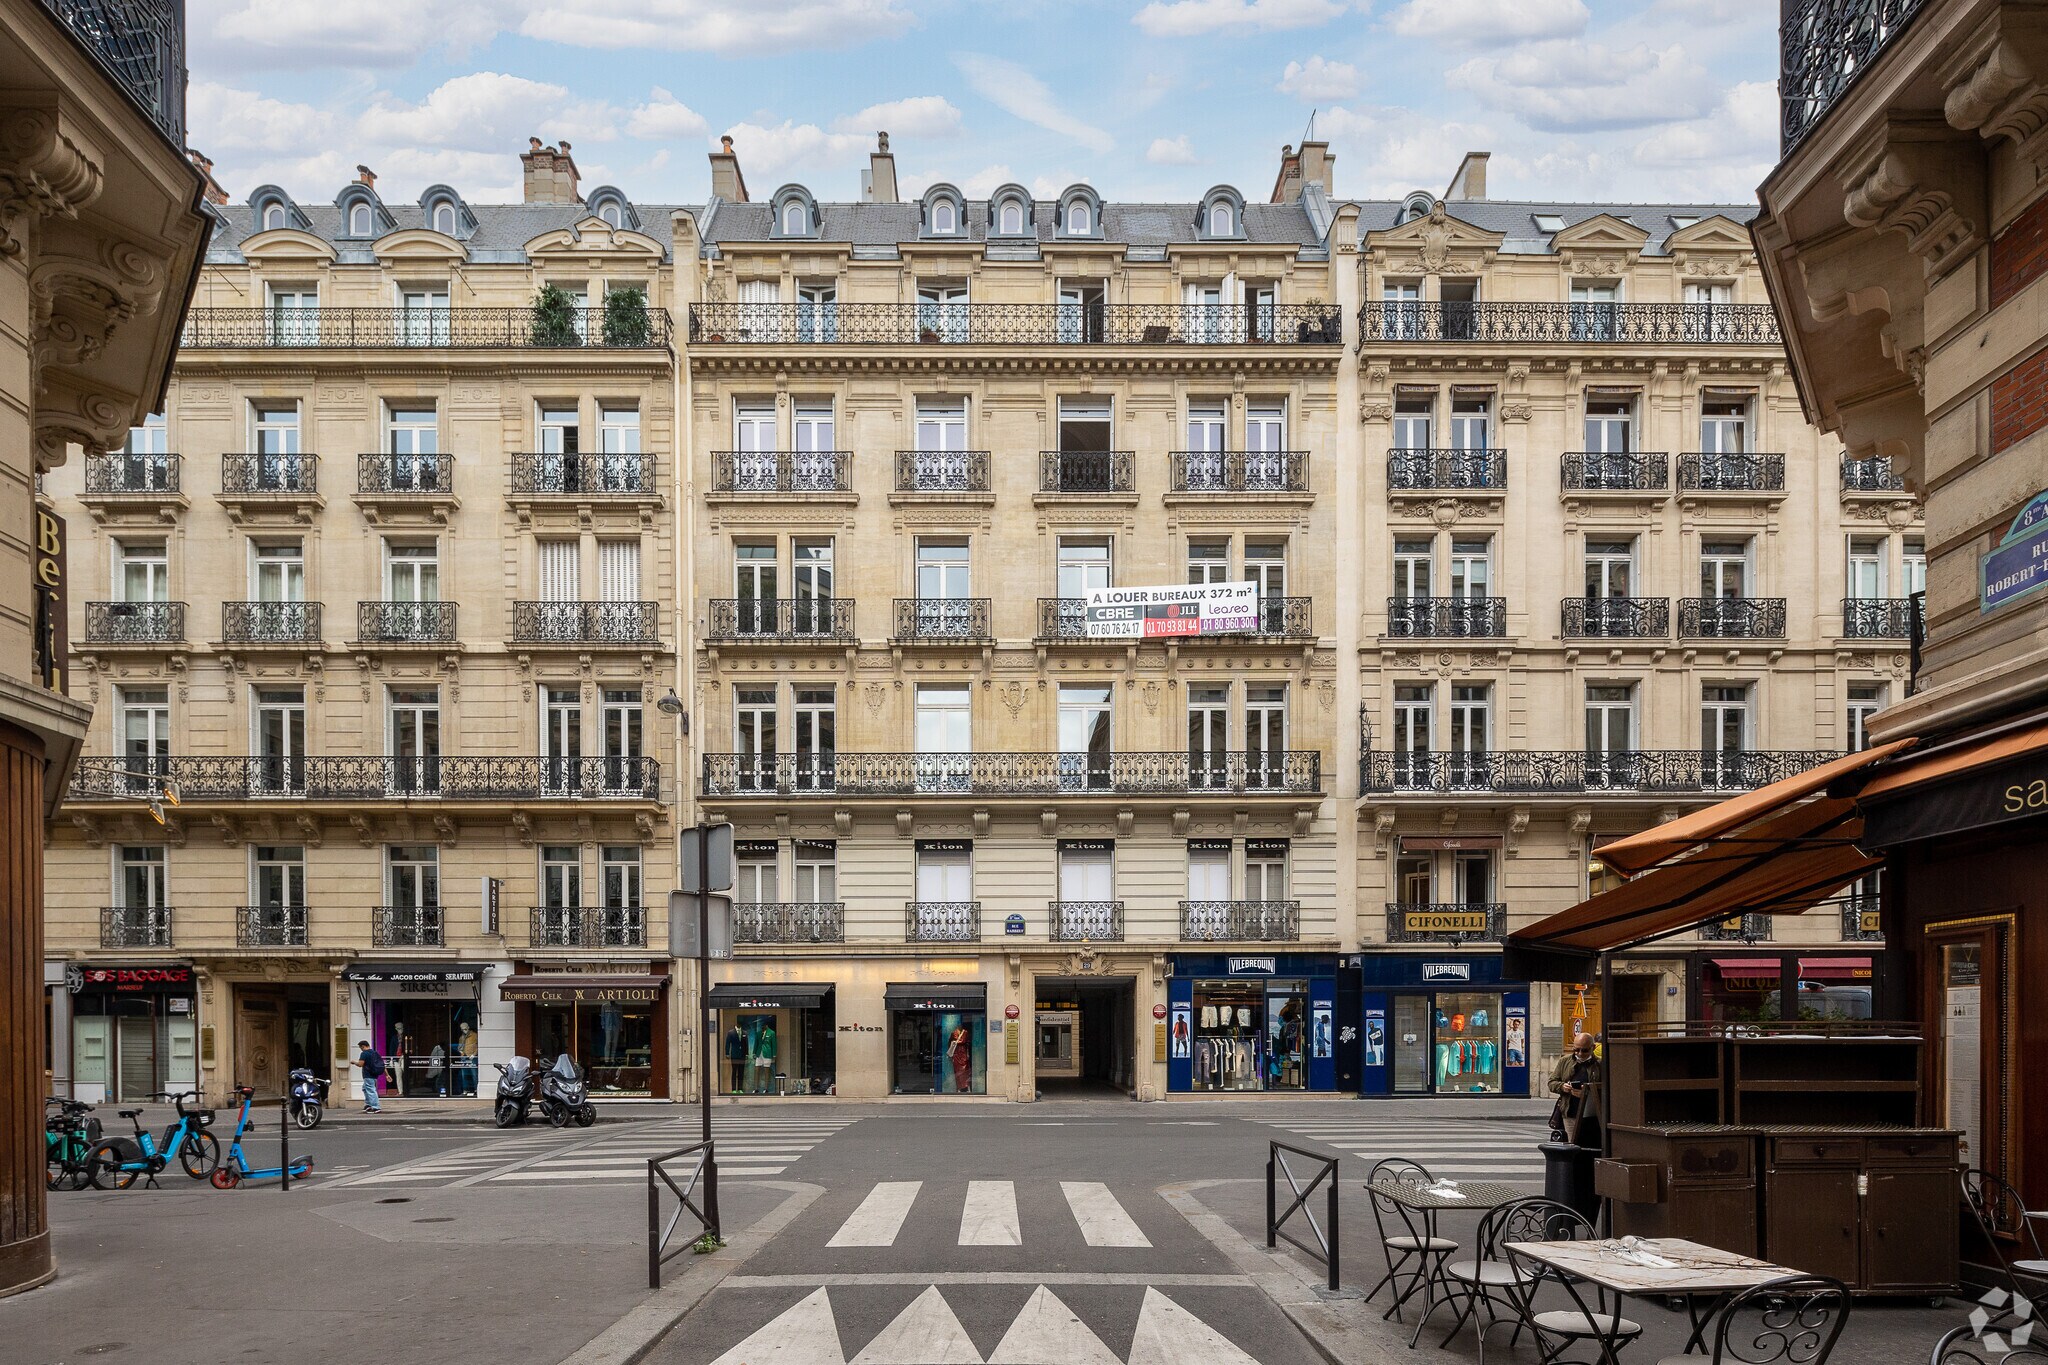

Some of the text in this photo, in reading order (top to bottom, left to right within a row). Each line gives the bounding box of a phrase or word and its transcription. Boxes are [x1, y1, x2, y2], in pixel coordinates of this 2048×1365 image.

[1093, 594, 1102, 604] A
[1107, 592, 1148, 603] LOUER
[1152, 590, 1206, 601] BUREAUX
[1210, 588, 1232, 598] 372
[1096, 608, 1134, 619] CBRE
[1180, 606, 1197, 615] JLL
[1091, 623, 1139, 635] 07 60 76 24 17
[1146, 620, 1197, 633] 01 70 93 81 44
[1408, 917, 1483, 927] CIFONELLI
[600, 964, 649, 974] ARTIOLI
[1231, 960, 1274, 972] VILEBREQUIN
[118, 970, 188, 982] BAGGAGE
[1425, 966, 1468, 978] VILEBREQUIN
[598, 990, 655, 999] ARTIOLI
[739, 999, 780, 1008] Kiton
[838, 1023, 884, 1032] Kiton
